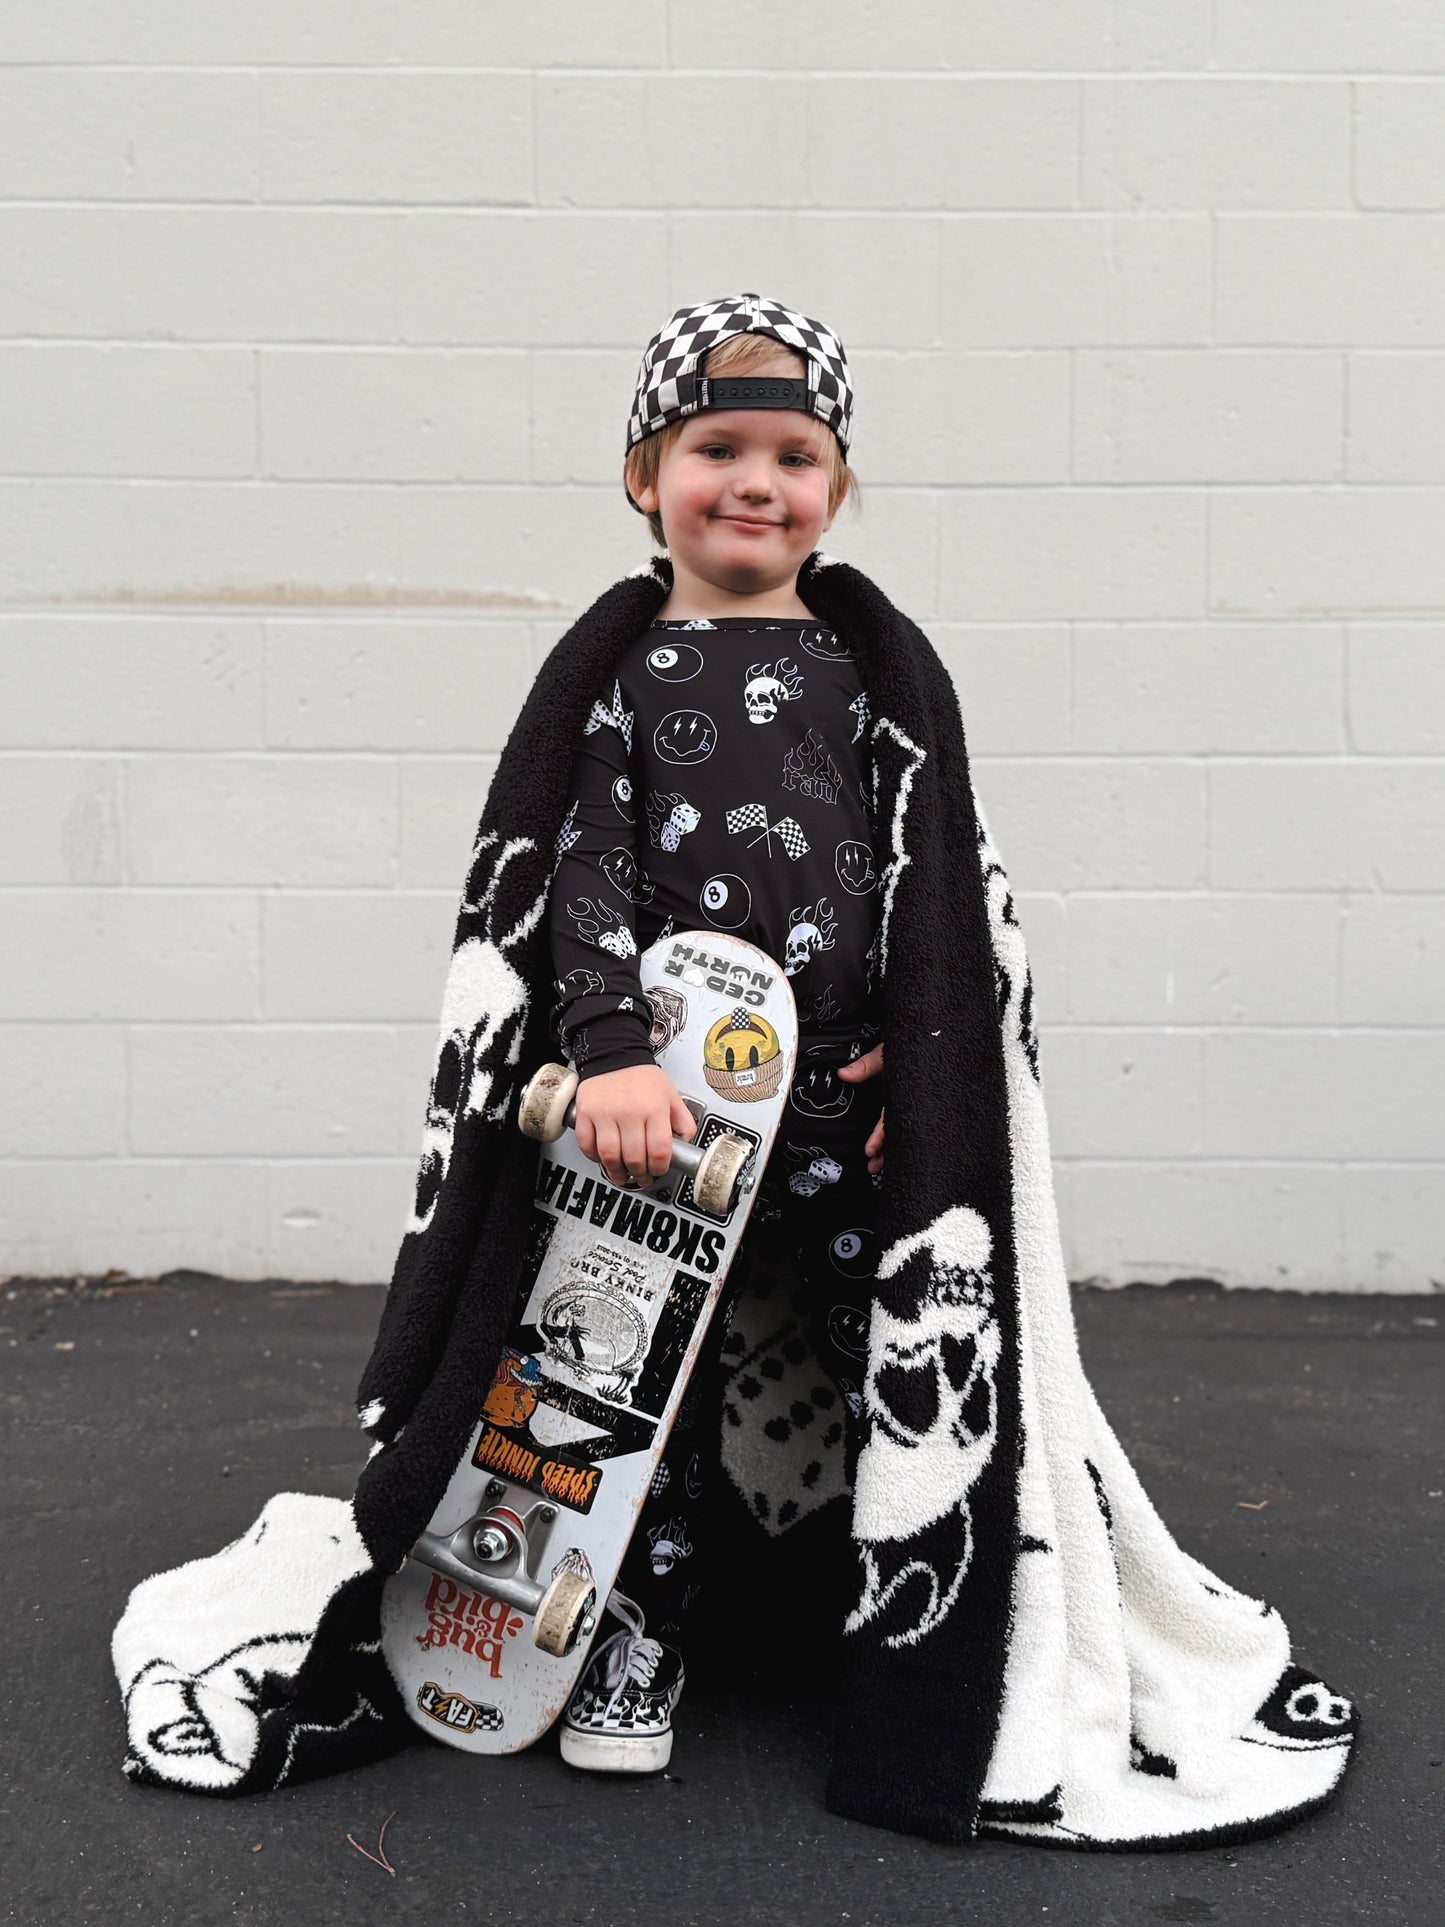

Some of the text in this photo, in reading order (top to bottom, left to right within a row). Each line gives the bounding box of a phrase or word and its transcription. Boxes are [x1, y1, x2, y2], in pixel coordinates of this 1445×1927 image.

[655, 652, 670, 664] 8
[781, 765, 844, 805] rad
[708, 886, 722, 902] 8
[671, 943, 774, 991] NORTH
[537, 1158, 726, 1274] SK8MAFIA
[840, 1237, 853, 1254] 8
[587, 1250, 647, 1285] Pool Service
[604, 1275, 655, 1302] BINKY
[476, 1427, 600, 1507] SPEED JUNKIE
[424, 1572, 513, 1640] bird
[416, 1611, 504, 1679] bug
[473, 1620, 492, 1638] &
